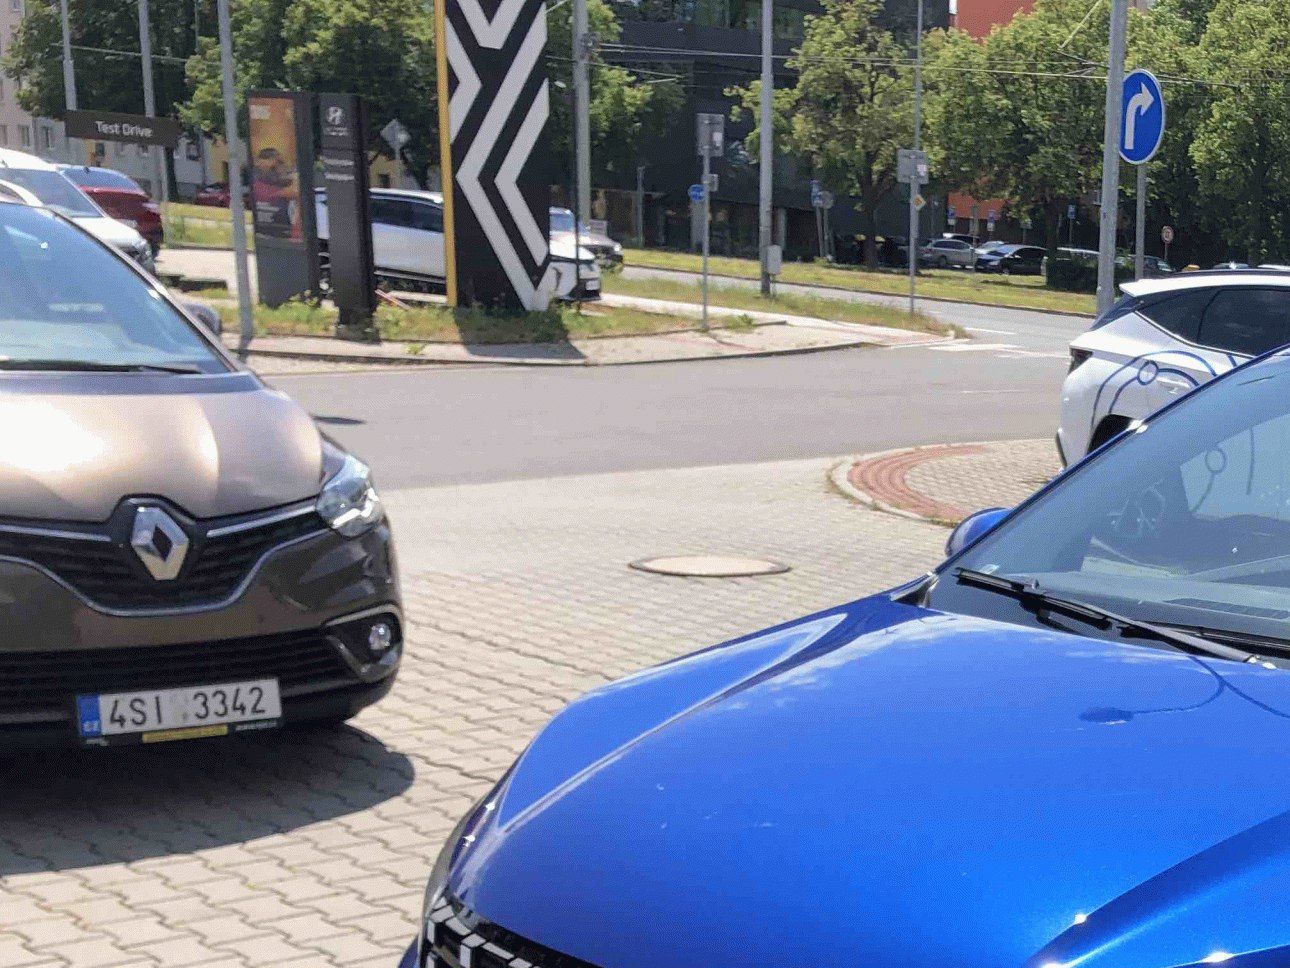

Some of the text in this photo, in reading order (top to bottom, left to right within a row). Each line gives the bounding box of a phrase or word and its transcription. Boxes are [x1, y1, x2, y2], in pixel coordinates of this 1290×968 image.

[95, 121, 153, 137] Test Drive
[193, 686, 266, 719] 3342
